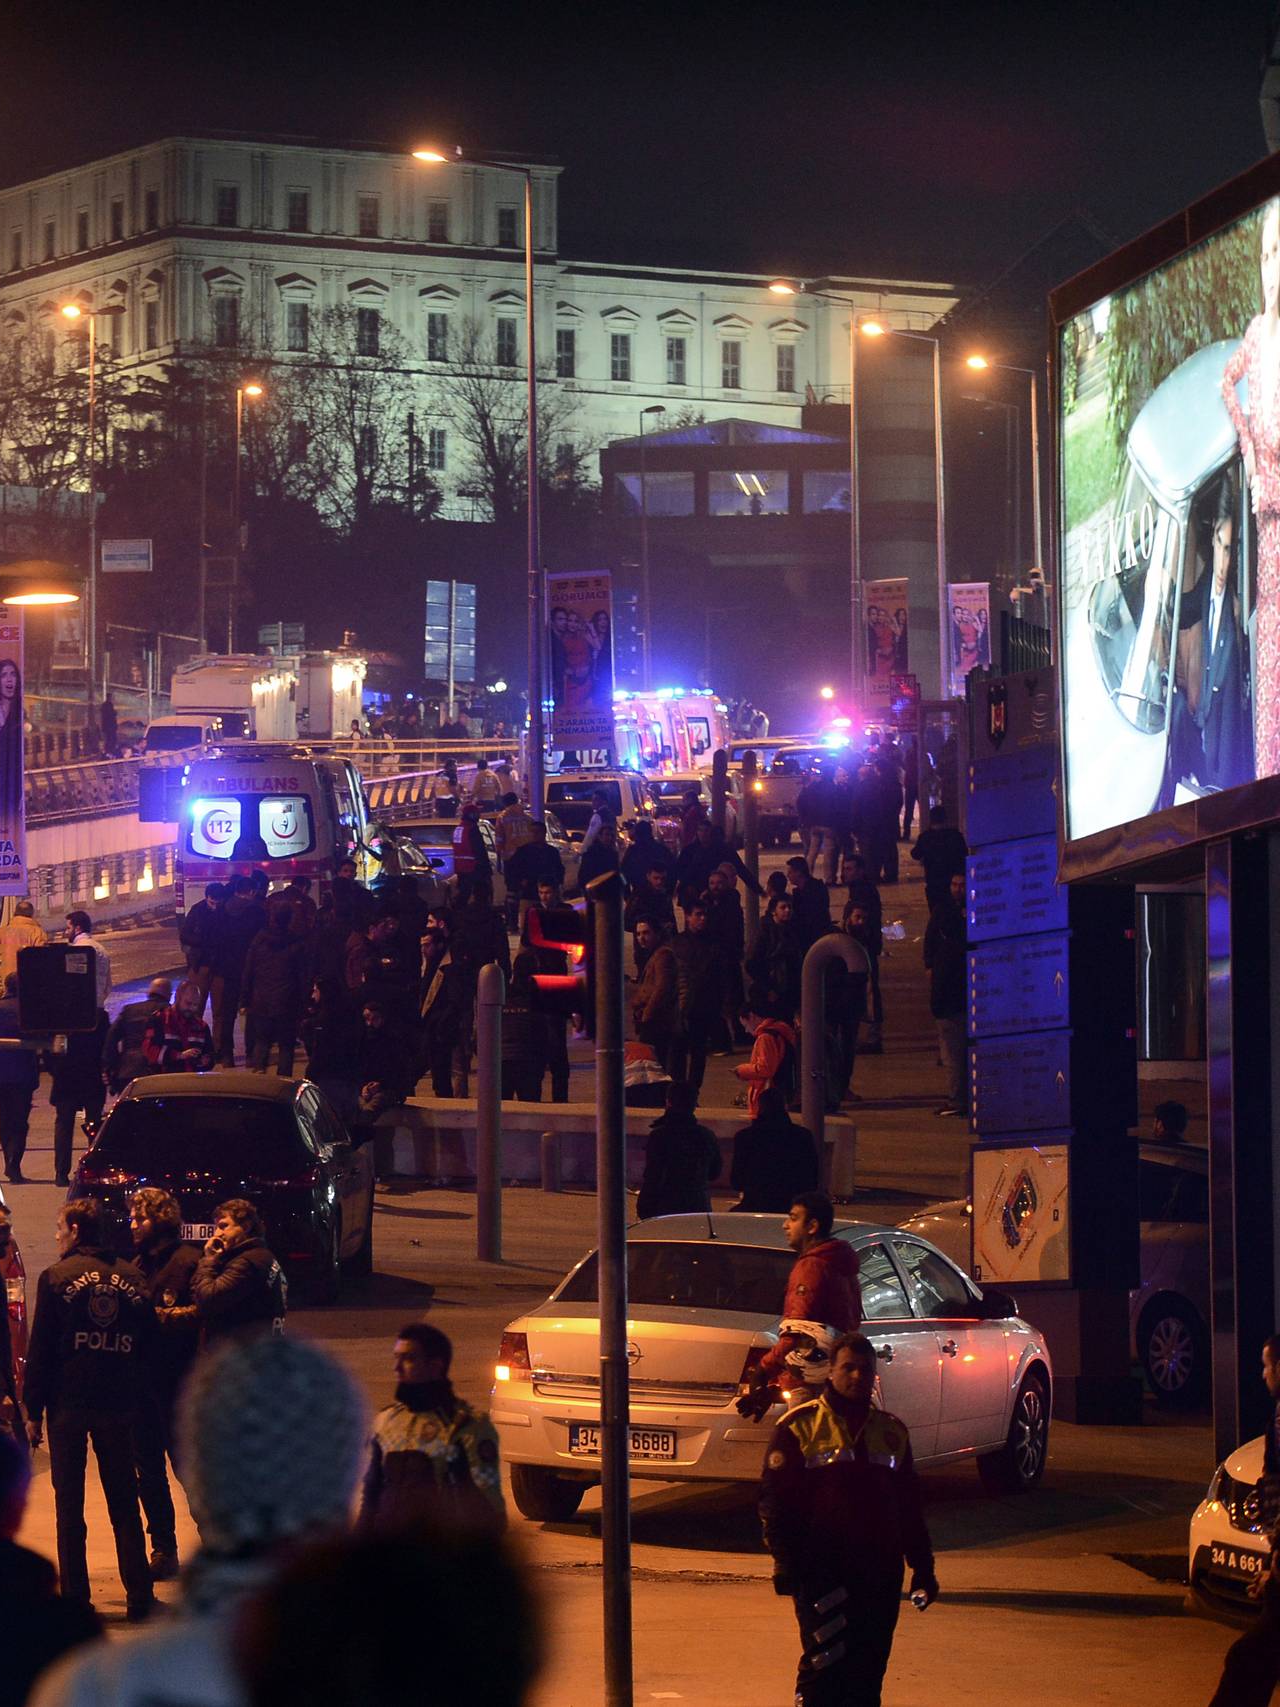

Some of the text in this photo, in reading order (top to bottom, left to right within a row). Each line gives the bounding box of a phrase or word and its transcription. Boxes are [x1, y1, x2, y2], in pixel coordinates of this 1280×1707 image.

[209, 820, 233, 833] 112
[74, 1331, 133, 1353] POLİS
[579, 1429, 670, 1452] 34 6688
[1211, 1547, 1263, 1572] 34 A 661
